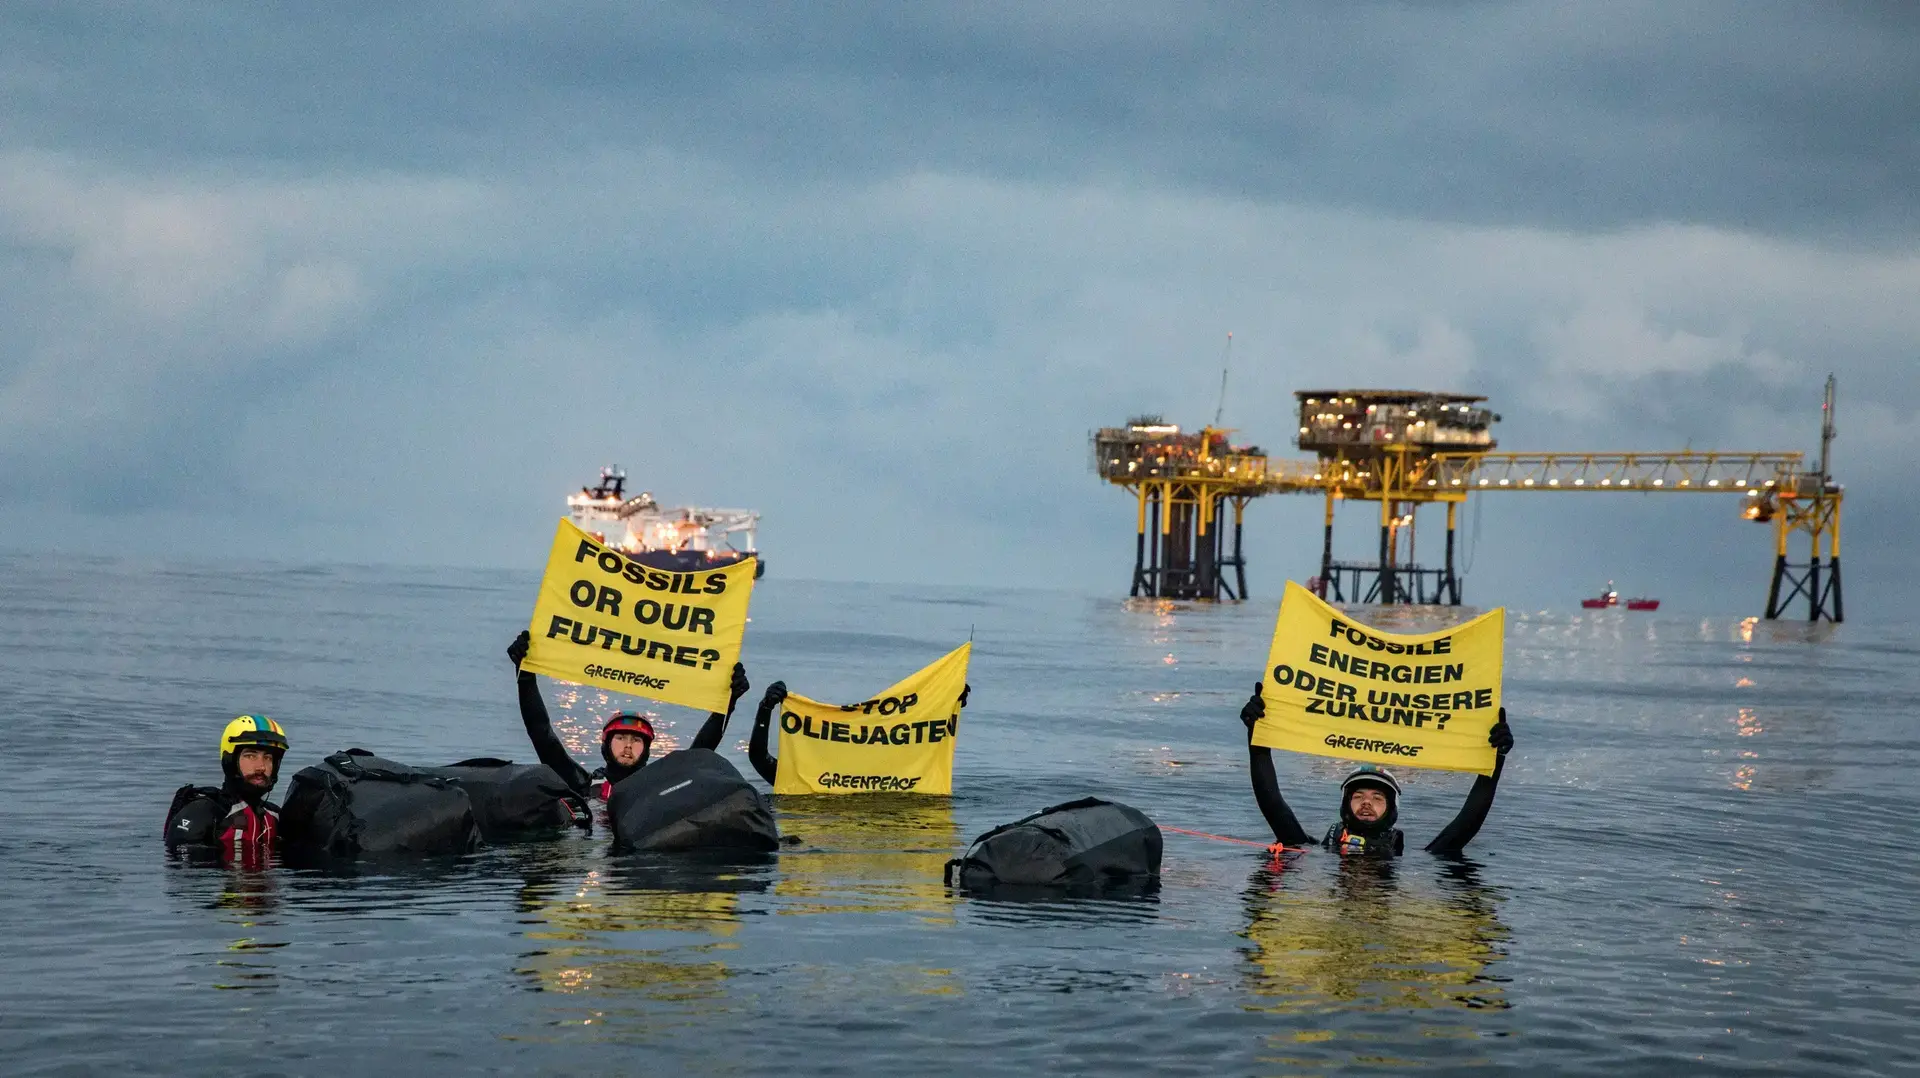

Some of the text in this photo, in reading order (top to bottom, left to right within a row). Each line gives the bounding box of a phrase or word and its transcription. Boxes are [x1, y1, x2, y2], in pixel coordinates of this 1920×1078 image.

[574, 538, 728, 595] FOSSILS
[570, 579, 716, 635] OR OUR
[546, 614, 721, 671] FUTURE?
[1329, 618, 1452, 656] FOSSILE
[583, 664, 670, 690] GREENPEACE
[1309, 642, 1464, 684] ENERGIEN
[1273, 664, 1493, 711] ODER UNSERE
[780, 711, 958, 746] OLIEJAGTEN
[1305, 697, 1452, 731] ZUKUNF?
[1324, 733, 1424, 758] GREENPEACE
[818, 772, 921, 791] GREENPEACE
